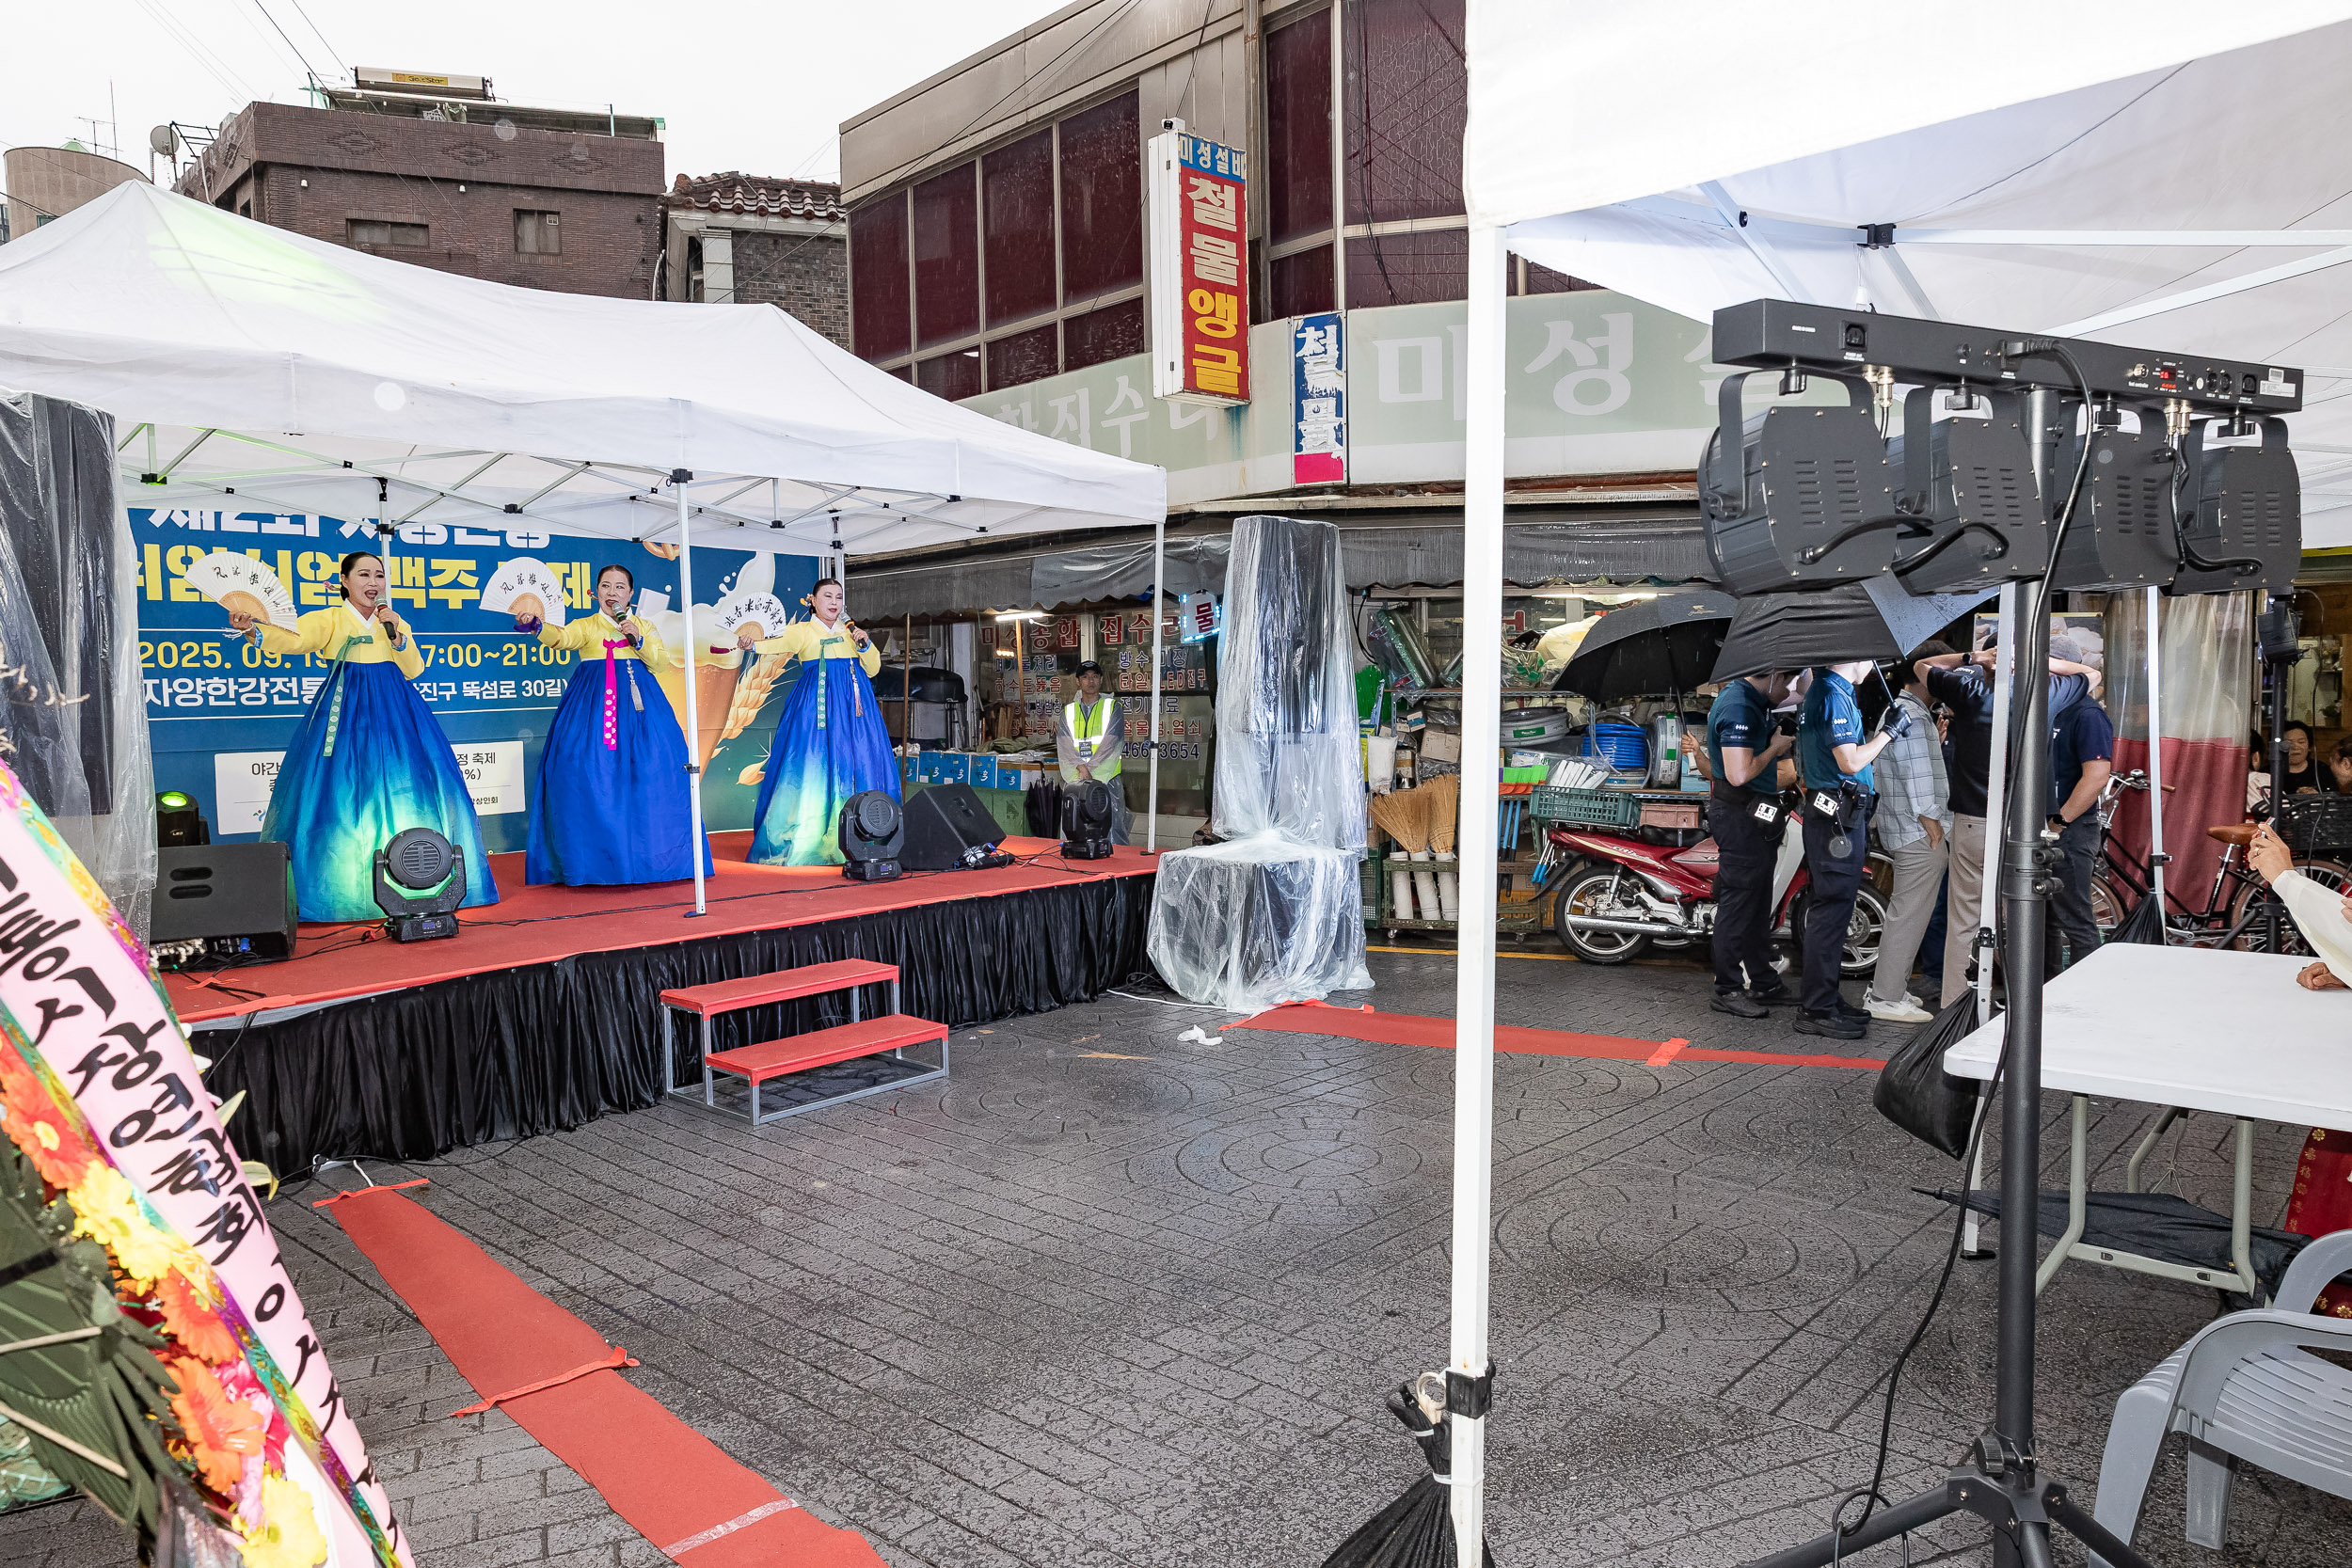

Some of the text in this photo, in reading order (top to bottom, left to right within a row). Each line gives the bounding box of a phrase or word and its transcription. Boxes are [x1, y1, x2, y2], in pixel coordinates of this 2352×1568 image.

[1180, 135, 1246, 182] 미성설비
[1187, 176, 1242, 395] 철물 앵글
[1195, 602, 1215, 634] 물
[138, 641, 231, 669] 2025.
[417, 682, 457, 703] 진구
[462, 680, 519, 700] 뚝섬로
[472, 752, 496, 765] 축제
[1121, 741, 1200, 760] 4663654
[0, 852, 264, 1265] 통시장연합회
